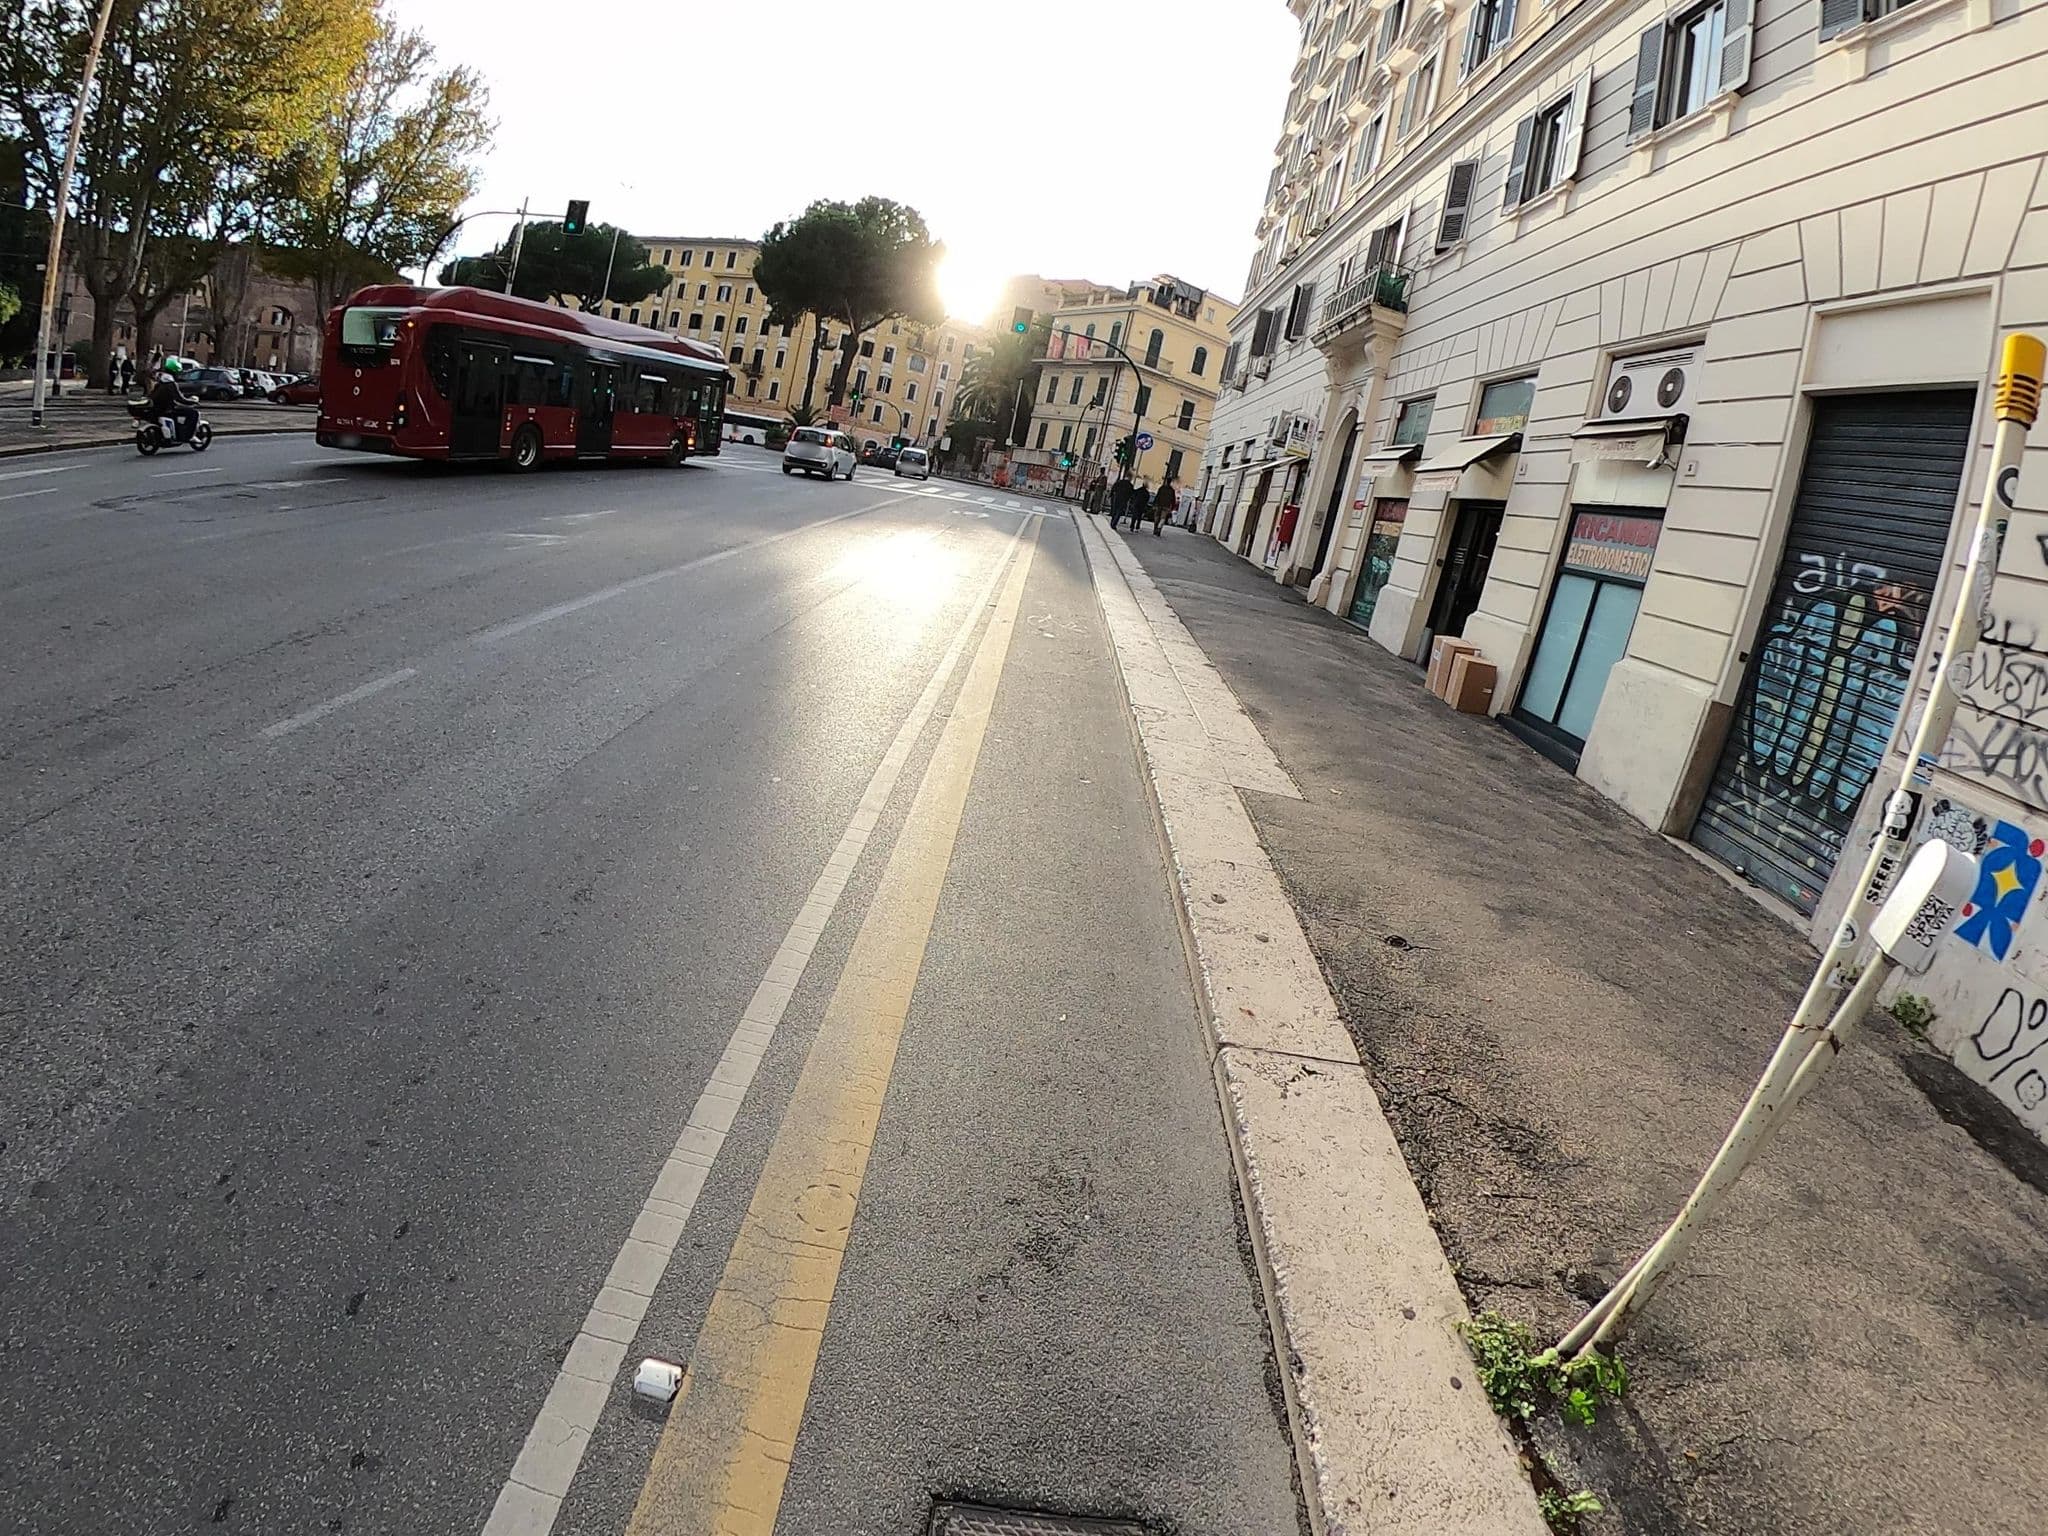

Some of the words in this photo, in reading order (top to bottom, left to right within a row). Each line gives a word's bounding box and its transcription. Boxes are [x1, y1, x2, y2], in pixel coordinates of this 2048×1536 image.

[1573, 515, 1661, 548] RICAMBI
[1564, 542, 1652, 577] ELETTRODOMESTICI
[1866, 857, 1893, 902] SEER
[1930, 907, 1955, 930] VITA
